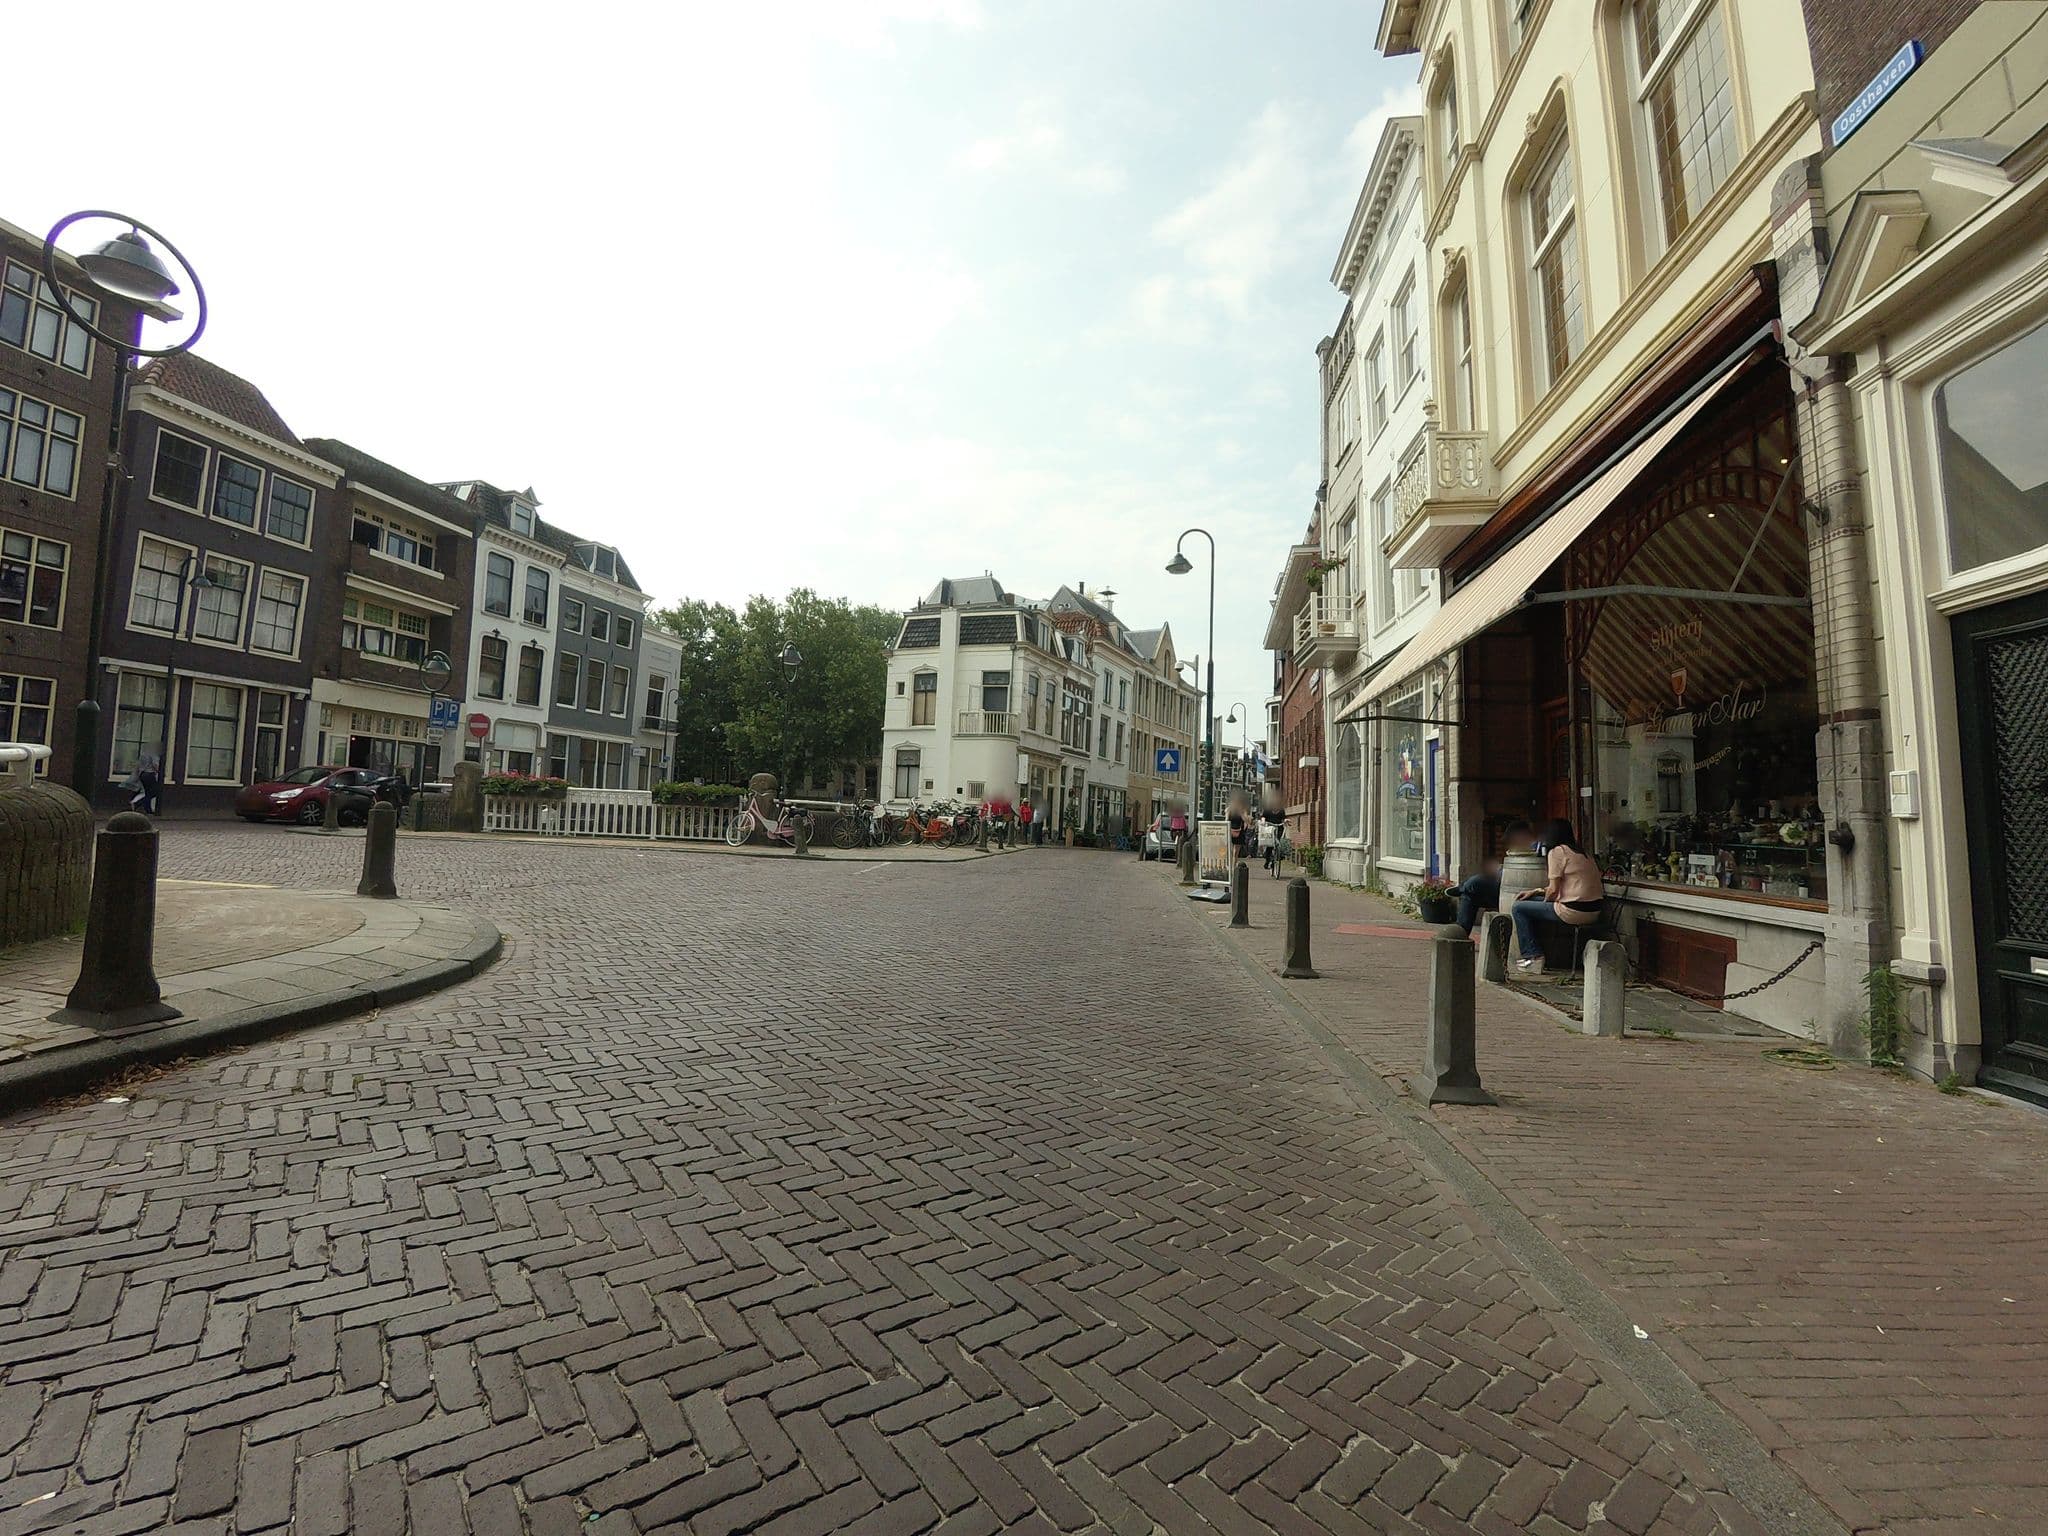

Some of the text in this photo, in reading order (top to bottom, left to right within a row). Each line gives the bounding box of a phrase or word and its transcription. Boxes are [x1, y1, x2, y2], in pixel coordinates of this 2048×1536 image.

[1840, 58, 1906, 132] Oosthaven
[1648, 613, 1703, 652] Slijterij
[434, 701, 444, 716] P
[449, 703, 458, 718] P
[1903, 734, 1911, 747] 7
